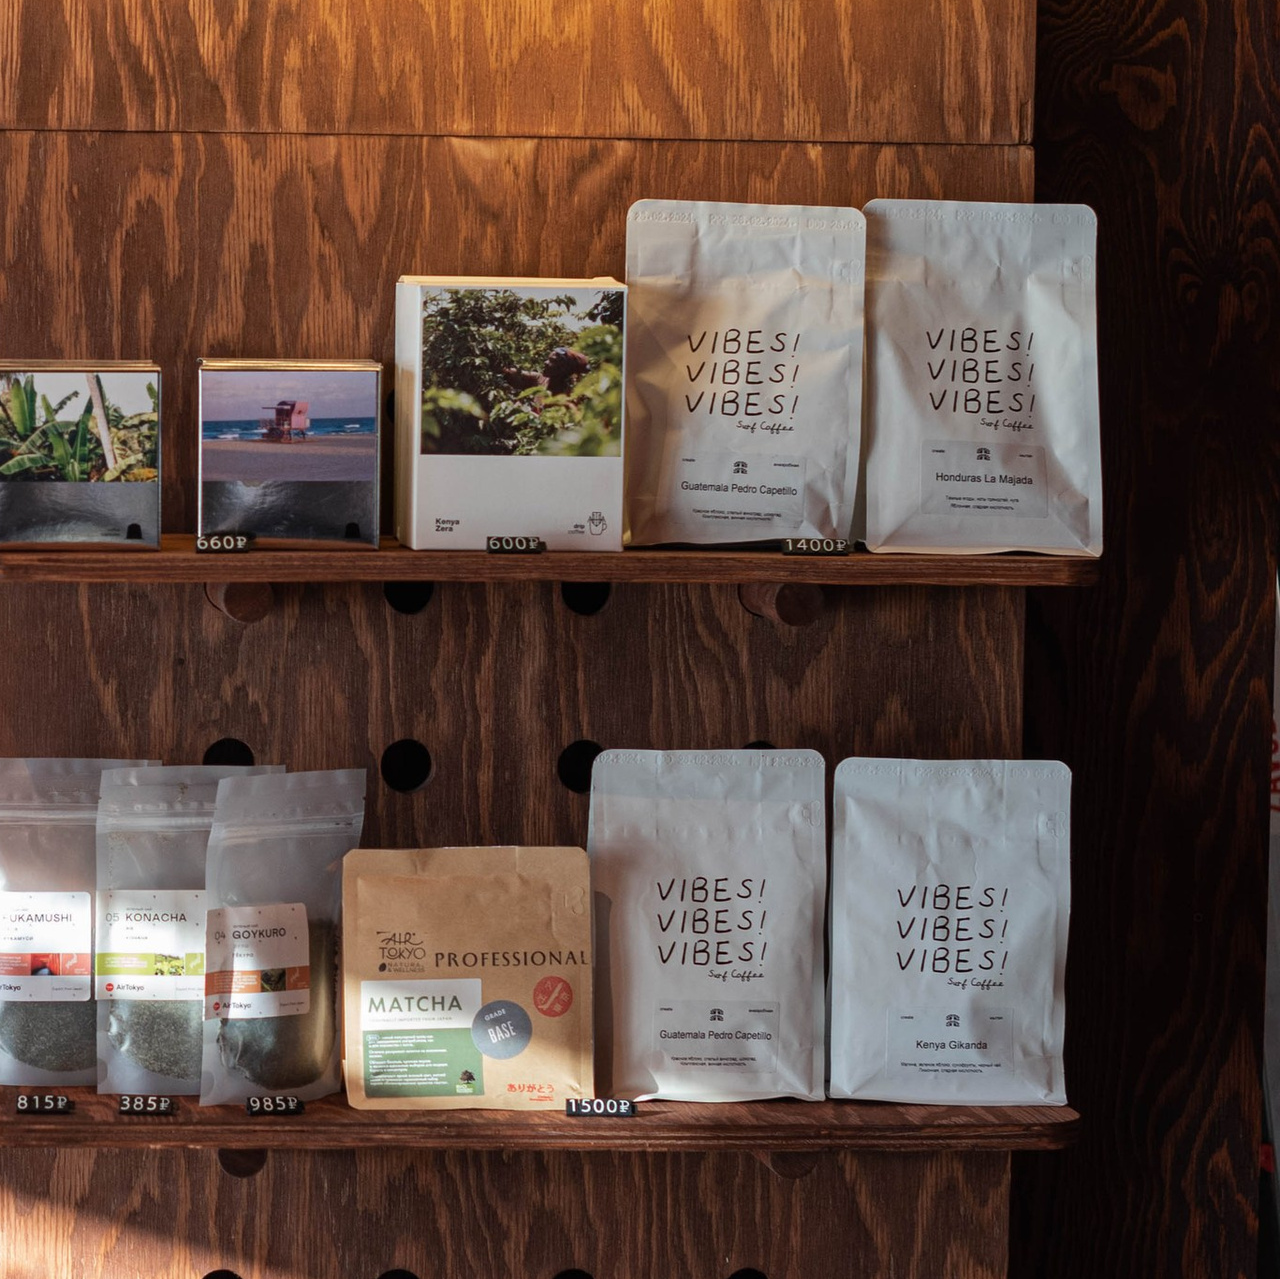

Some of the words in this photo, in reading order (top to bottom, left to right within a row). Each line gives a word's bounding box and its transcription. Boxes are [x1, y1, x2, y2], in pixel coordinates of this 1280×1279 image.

[687, 328, 801, 358] VIBES!
[926, 327, 1034, 357] VIBES!
[686, 359, 800, 388] VIBES!
[927, 358, 1035, 387] VIBES!
[685, 389, 799, 420] VIBES!
[929, 388, 1036, 419] VIBES!
[736, 421, 757, 433] Surf
[760, 421, 795, 434] Coffee
[980, 418, 1000, 430] Surf
[1002, 418, 1034, 431] Coffee
[935, 472, 982, 483] Honduras
[984, 474, 996, 483] La
[999, 474, 1034, 486] Majada
[680, 481, 729, 492] Guatemala
[731, 483, 757, 494] Pedro
[759, 485, 798, 496] Capetillo
[657, 876, 766, 904] VIBES!
[897, 884, 1009, 913] VIBES!
[3, 913, 73, 923] UKAMUSHI
[105, 912, 120, 923] 05
[125, 912, 188, 923] KONACHA
[657, 907, 767, 935] VIBES!
[214, 931, 226, 941] 04
[232, 927, 287, 940] GOYKURO
[896, 915, 1008, 944] VIBES!
[379, 947, 426, 960] TOKYO
[435, 949, 589, 969] PROFESSIONAL
[657, 939, 768, 967] VIBES!
[896, 947, 1008, 975] VIBES!
[708, 969, 728, 982] Surf
[731, 969, 765, 982] Coffee
[947, 977, 968, 990] Surf
[970, 977, 1005, 990] Coffee
[368, 995, 463, 1013] MATCHA
[484, 1008, 507, 1021] GRADE
[487, 1020, 517, 1044] BASE
[659, 1029, 706, 1039] Guatemala
[708, 1030, 733, 1040] Pedro
[735, 1030, 772, 1041] Capetillo
[916, 1040, 946, 1051] Kenya
[948, 1040, 988, 1050] Gikanda
[506, 1083, 555, 1094] ありがとう
[17, 1095, 68, 1110] 815₽
[120, 1096, 170, 1111] 385₽
[249, 1096, 298, 1111] 985₽
[569, 1098, 630, 1114] 1500₽
